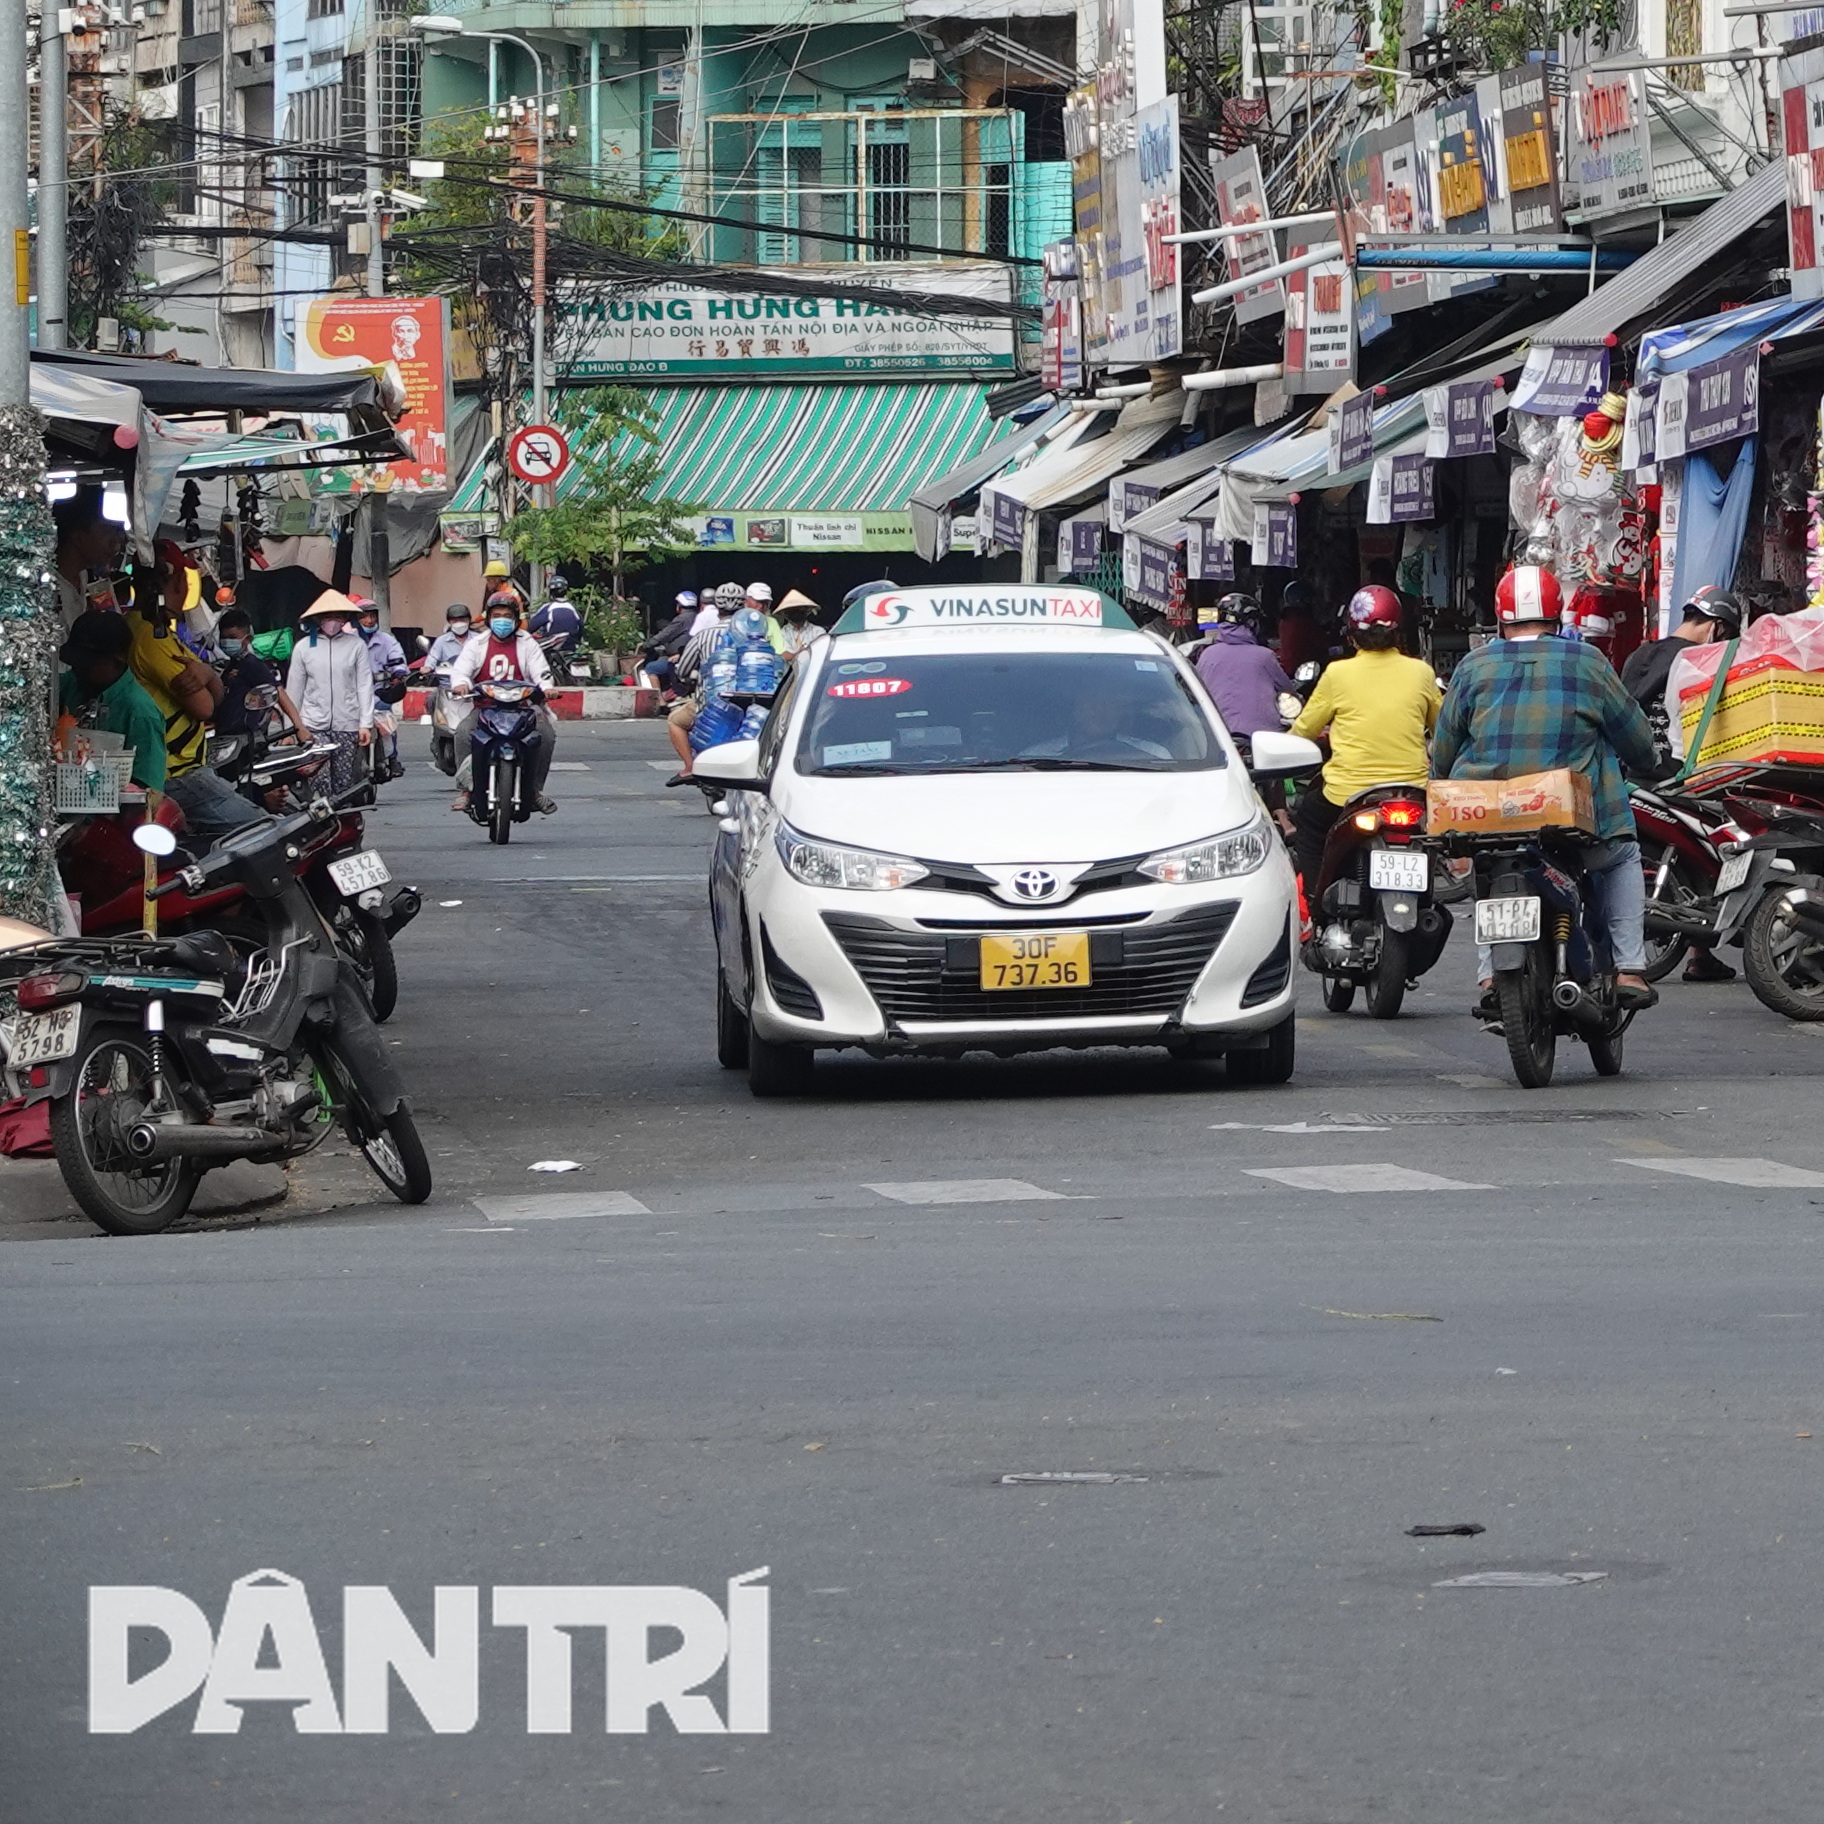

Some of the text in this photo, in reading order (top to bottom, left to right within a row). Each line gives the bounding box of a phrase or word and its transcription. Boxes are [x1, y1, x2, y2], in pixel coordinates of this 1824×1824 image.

[631, 326, 664, 338] CAO
[670, 324, 704, 338] ĐƠN
[710, 321, 755, 337] HOÀN
[761, 321, 795, 336] TÁN
[800, 320, 827, 336] NỘI
[833, 319, 860, 336] ĐỊA
[865, 318, 887, 334] VÀ
[591, 358, 867, 375] HƯNG ĐẠO ĐT:
[832, 679, 902, 697] 11807
[336, 854, 377, 877] 59-K2
[1380, 854, 1418, 873] 59-L2
[341, 868, 388, 893] 457.86
[1374, 871, 1424, 888] 318.33
[1011, 937, 1057, 960] 30F
[993, 963, 1079, 987] 737.36
[18, 1034, 64, 1060] 5798
